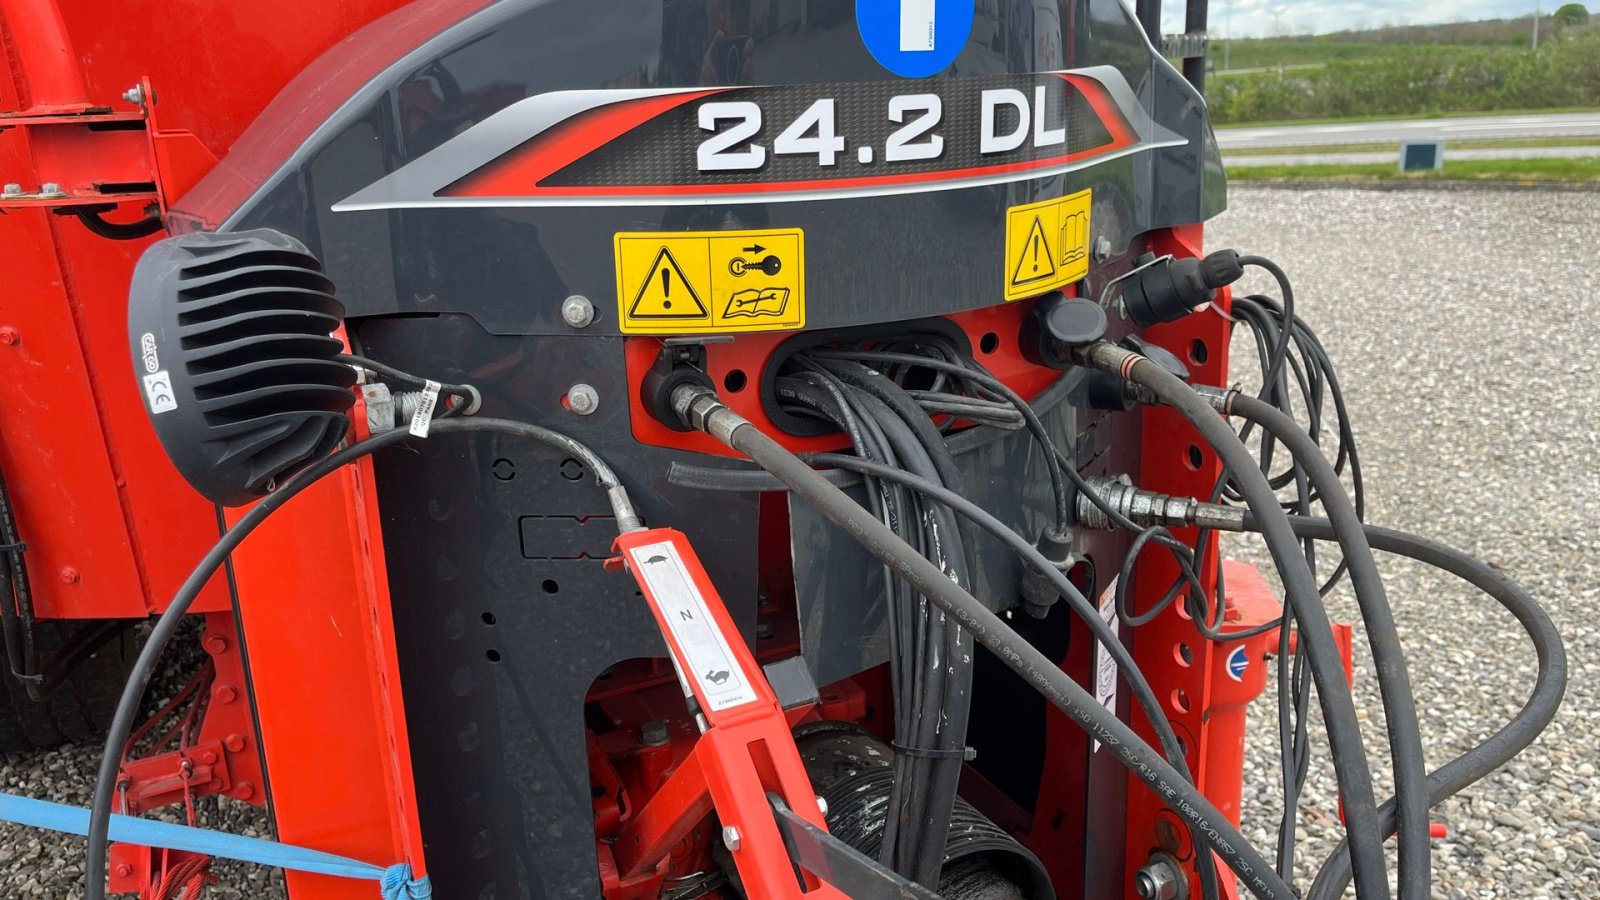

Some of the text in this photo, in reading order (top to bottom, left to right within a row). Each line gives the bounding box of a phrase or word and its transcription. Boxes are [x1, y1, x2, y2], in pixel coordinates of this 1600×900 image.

[697, 85, 1066, 171] 24.2 DL
[419, 397, 433, 426] QC PASS
[680, 609, 694, 622] N
[1072, 705, 1092, 724] ISO
[1091, 721, 1121, 748] 11237
[1155, 779, 1177, 800] SAE
[1174, 797, 1237, 858] 100R16/EN857
[1232, 855, 1255, 877] 2SC
